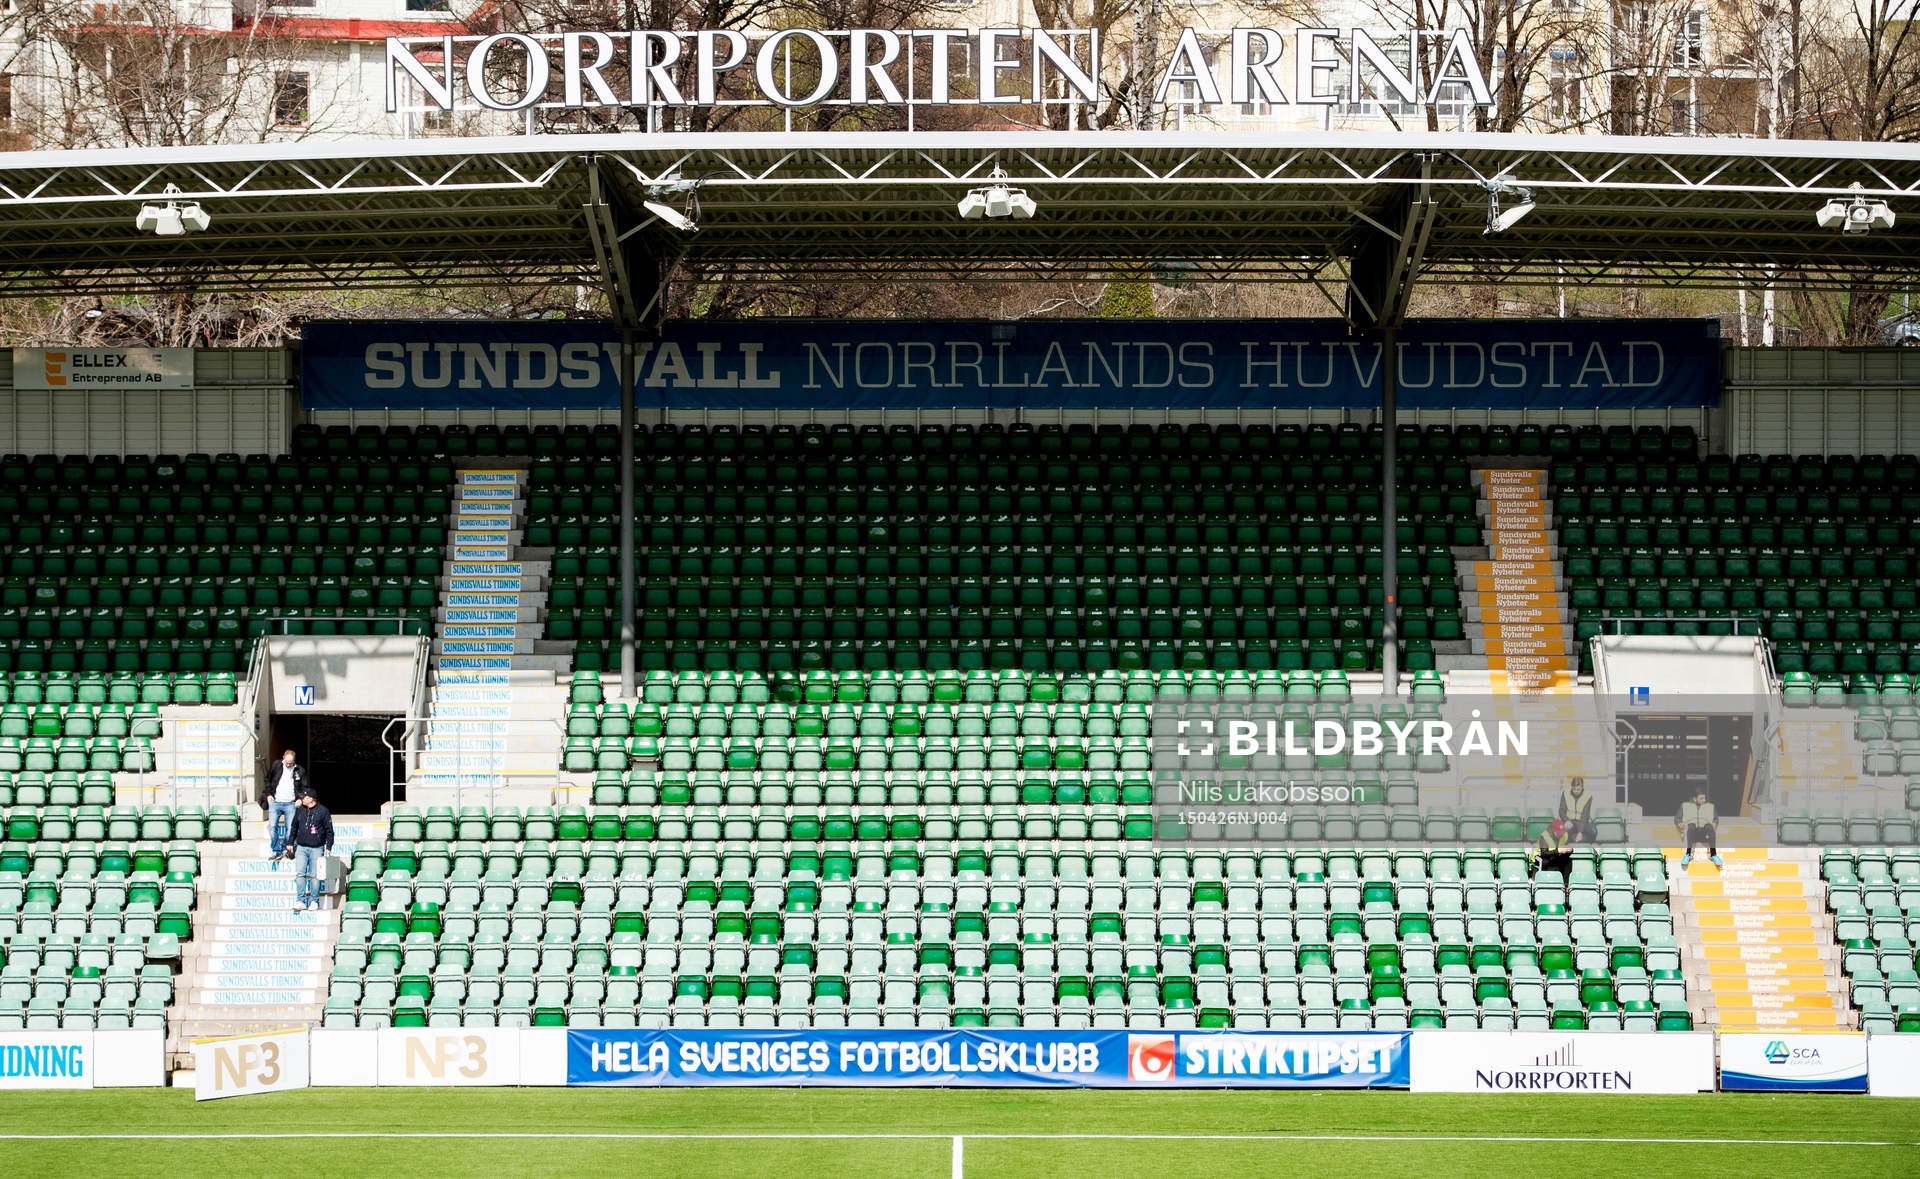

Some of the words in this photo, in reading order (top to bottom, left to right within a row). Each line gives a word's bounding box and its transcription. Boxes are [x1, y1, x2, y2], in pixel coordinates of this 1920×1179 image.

[386, 28, 1100, 113] NORRPORTEN
[1153, 27, 1496, 106] ARENA
[364, 342, 781, 390] SUNDSVALL
[802, 341, 1214, 390] NORRLANDS
[1239, 341, 1665, 389] HUVUDSTAD
[72, 373, 142, 384] Entreprenad
[145, 374, 162, 382] AB
[453, 565, 493, 574] SUNDSVALLS
[495, 565, 520, 574] TIDNING
[452, 580, 492, 589] SUNDSVALLS
[494, 580, 519, 589] TIDNING
[450, 596, 490, 605] SUNDSVALLS
[492, 596, 518, 605] TIDNING
[447, 612, 488, 620] SUNDSVALLS
[490, 612, 516, 620] TIDNING
[445, 627, 486, 636] SUNDSVALLS
[488, 627, 514, 636] TIDNING
[444, 643, 485, 652] SUNDSVALLS
[487, 643, 513, 652] TIDNING
[440, 659, 481, 668] SUNDSVALLS
[483, 659, 510, 668] TIDNING
[438, 675, 480, 684] SUNDSVALLS
[482, 675, 508, 684] TIDNING
[296, 688, 313, 704] M
[1634, 688, 1646, 704] L
[405, 1035, 487, 1078] NP3
[591, 1042, 670, 1072] HELA
[679, 1041, 830, 1073] SVERIGES
[840, 1041, 1099, 1073] FOTBOLLSKLUBB
[1185, 1038, 1393, 1075] STRYKTIPSET
[1792, 1048, 1820, 1059] SCA
[0, 1045, 83, 1077] IDNING
[214, 1041, 281, 1090] NP3
[1476, 1070, 1632, 1091] NORRPORTEN
